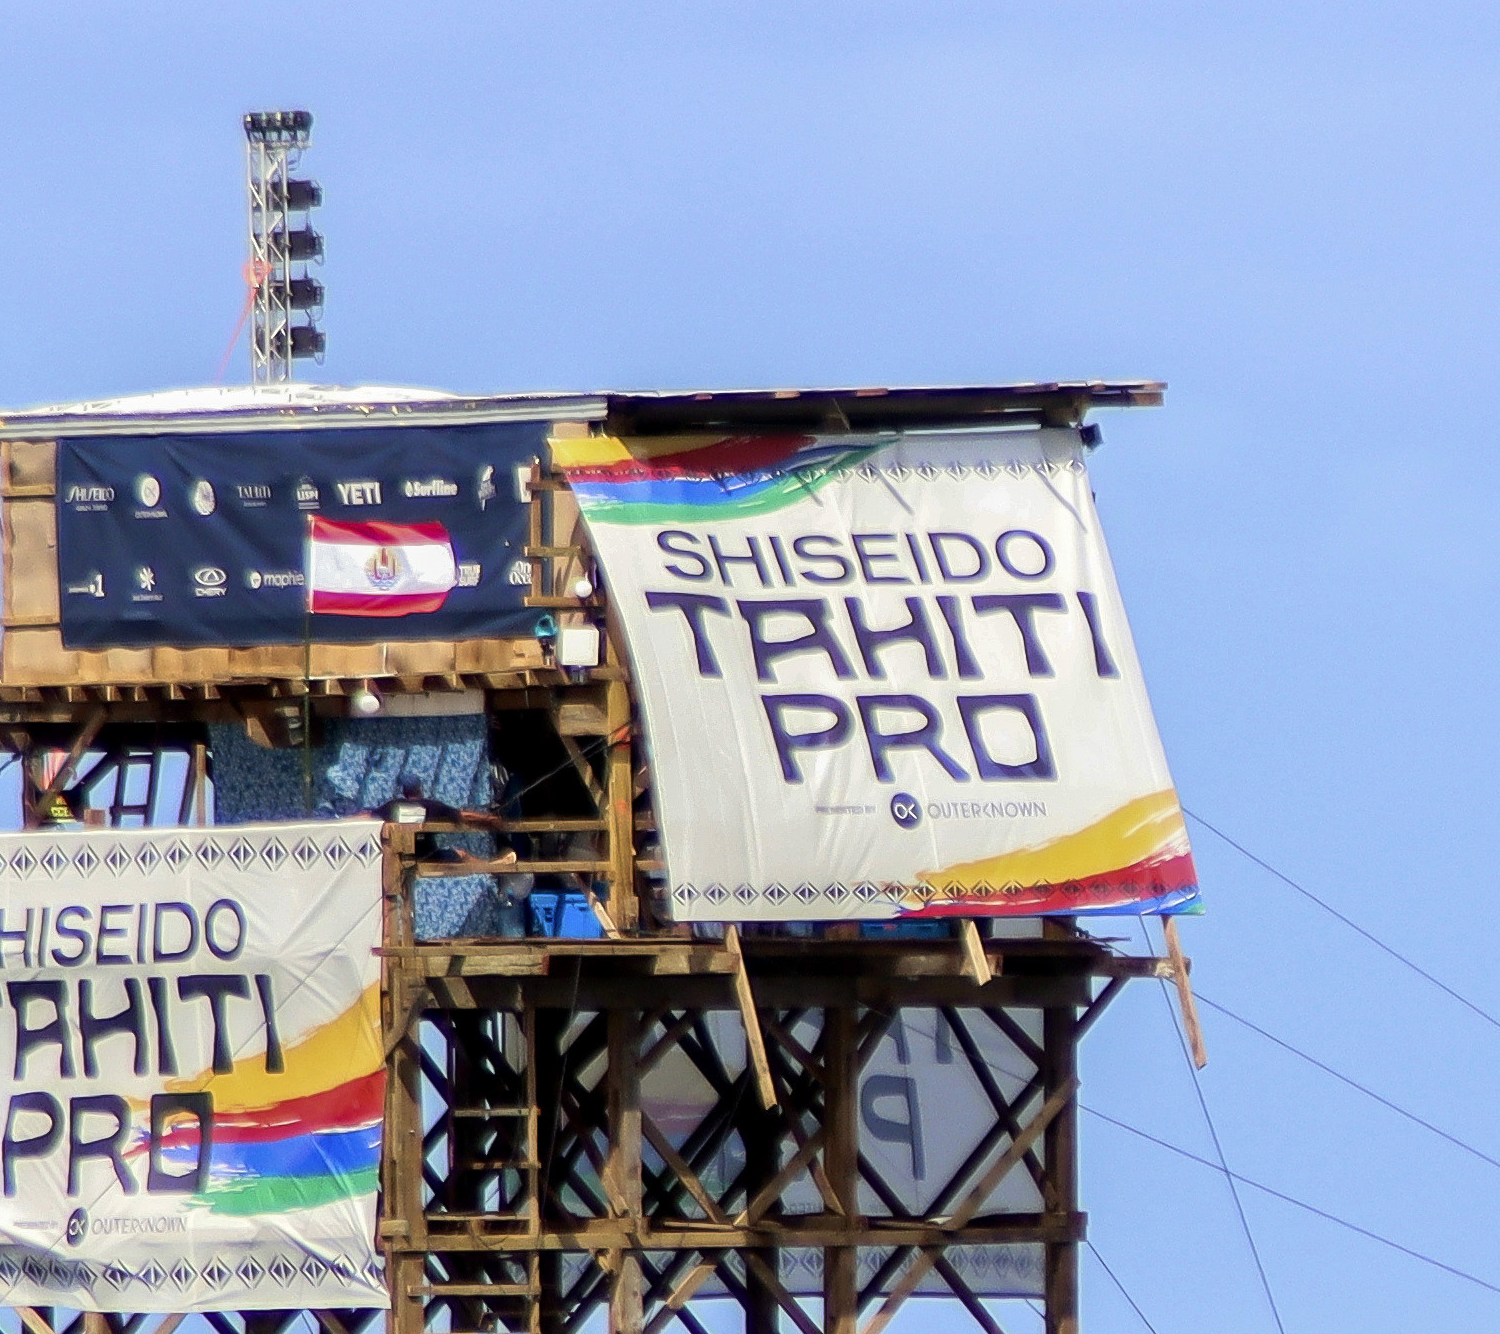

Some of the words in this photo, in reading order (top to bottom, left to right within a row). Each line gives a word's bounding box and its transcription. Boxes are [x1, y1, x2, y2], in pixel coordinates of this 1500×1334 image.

[337, 481, 382, 505] YETI
[263, 570, 305, 588] mophie
[656, 528, 1057, 587] SHISEIDO
[645, 590, 1122, 680] TAHITI
[761, 693, 1058, 784] PRO
[1, 1091, 214, 1198] PRO
